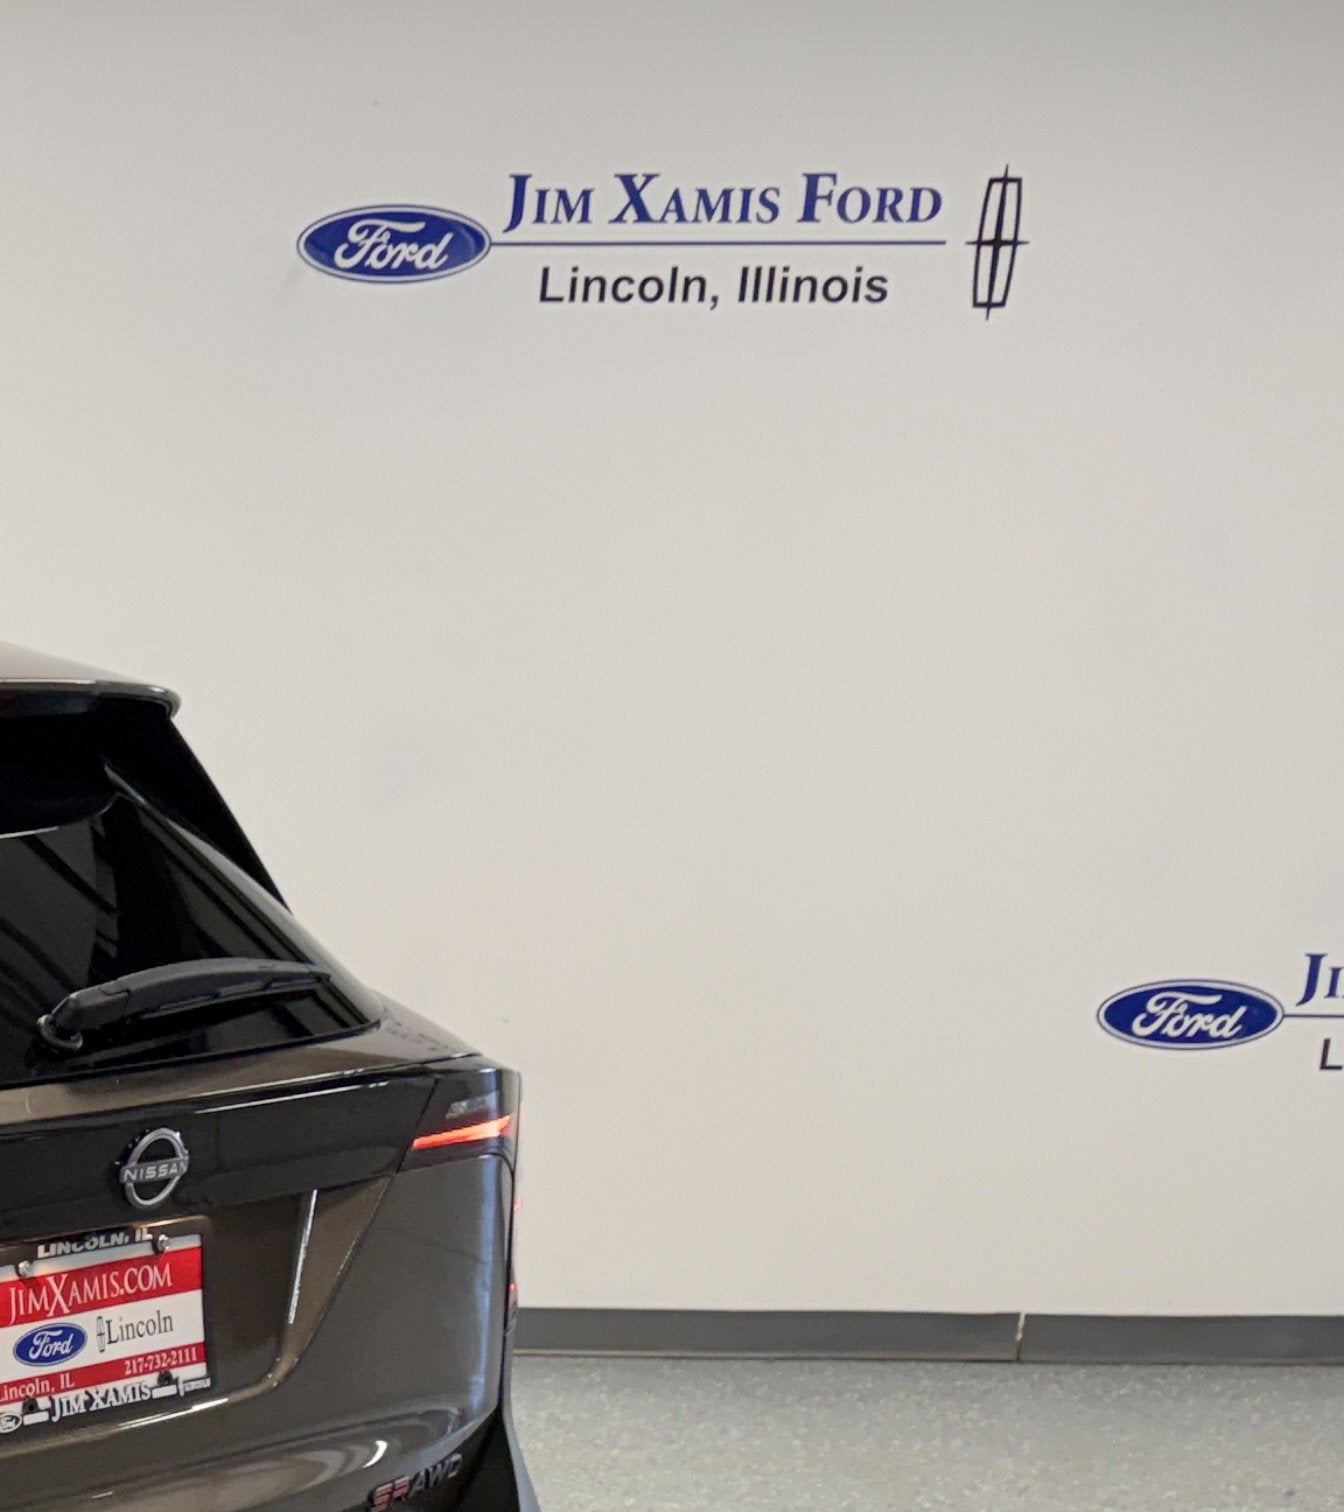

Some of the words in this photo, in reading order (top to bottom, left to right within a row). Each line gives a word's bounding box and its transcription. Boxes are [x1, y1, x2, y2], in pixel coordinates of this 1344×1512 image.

[502, 173, 593, 233] JIM
[611, 173, 780, 225] XAMIS
[797, 173, 943, 225] FORD
[334, 217, 449, 270] Ford
[539, 265, 719, 311] Lincoln,
[738, 265, 890, 303] Illinois
[1296, 953, 1344, 1007] JI
[1131, 990, 1248, 1038] Ford
[123, 1162, 188, 1182] NISSAN
[28, 1328, 73, 1360] Ford
[105, 1310, 174, 1345] Lincoln
[51, 1394, 86, 1423] JIM
[89, 1383, 152, 1412] XAMIS
[60, 1373, 76, 1391] IL
